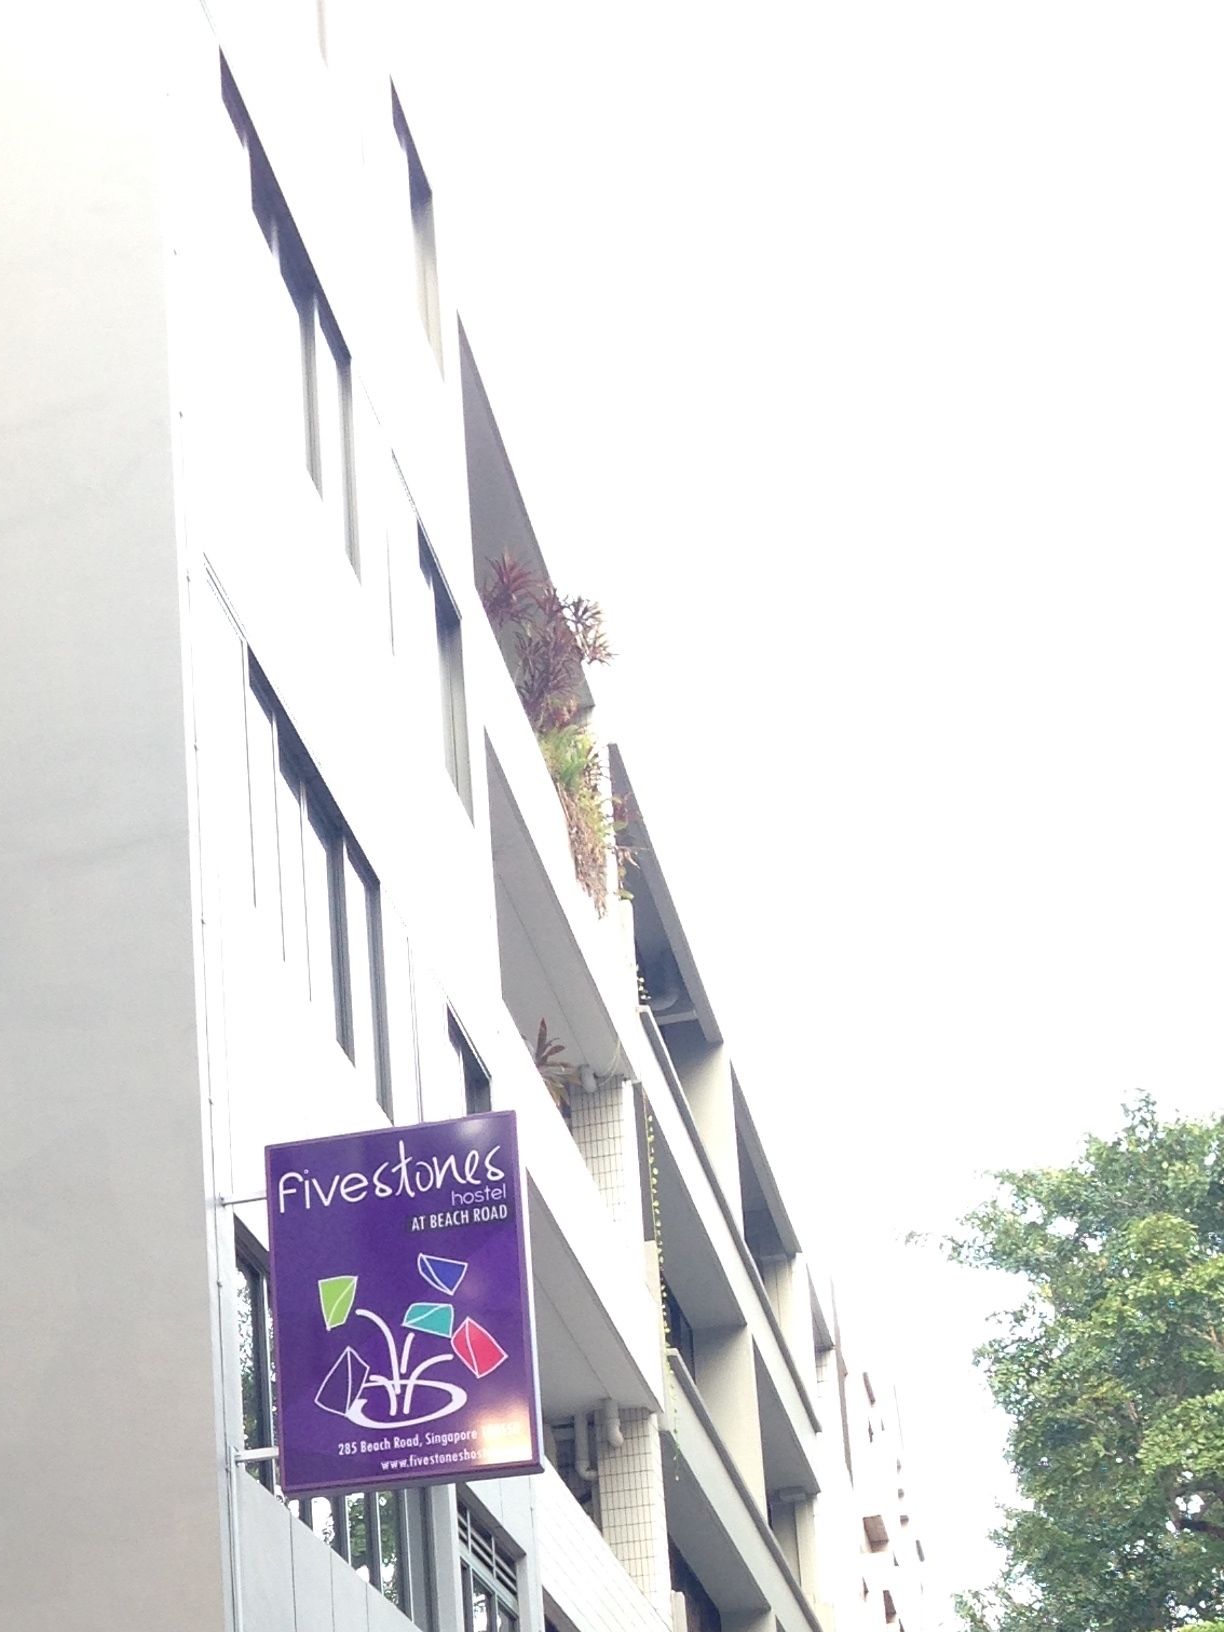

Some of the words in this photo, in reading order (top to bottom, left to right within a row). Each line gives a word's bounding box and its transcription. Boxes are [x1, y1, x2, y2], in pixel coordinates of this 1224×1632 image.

[451, 1183, 507, 1206] hostel
[411, 1216, 428, 1231] AT
[430, 1209, 470, 1229] BEACH
[473, 1204, 508, 1223] ROAD
[338, 1441, 357, 1456] 285
[359, 1436, 391, 1453] Beach
[394, 1431, 424, 1451] Road,
[425, 1428, 478, 1449] Singapore
